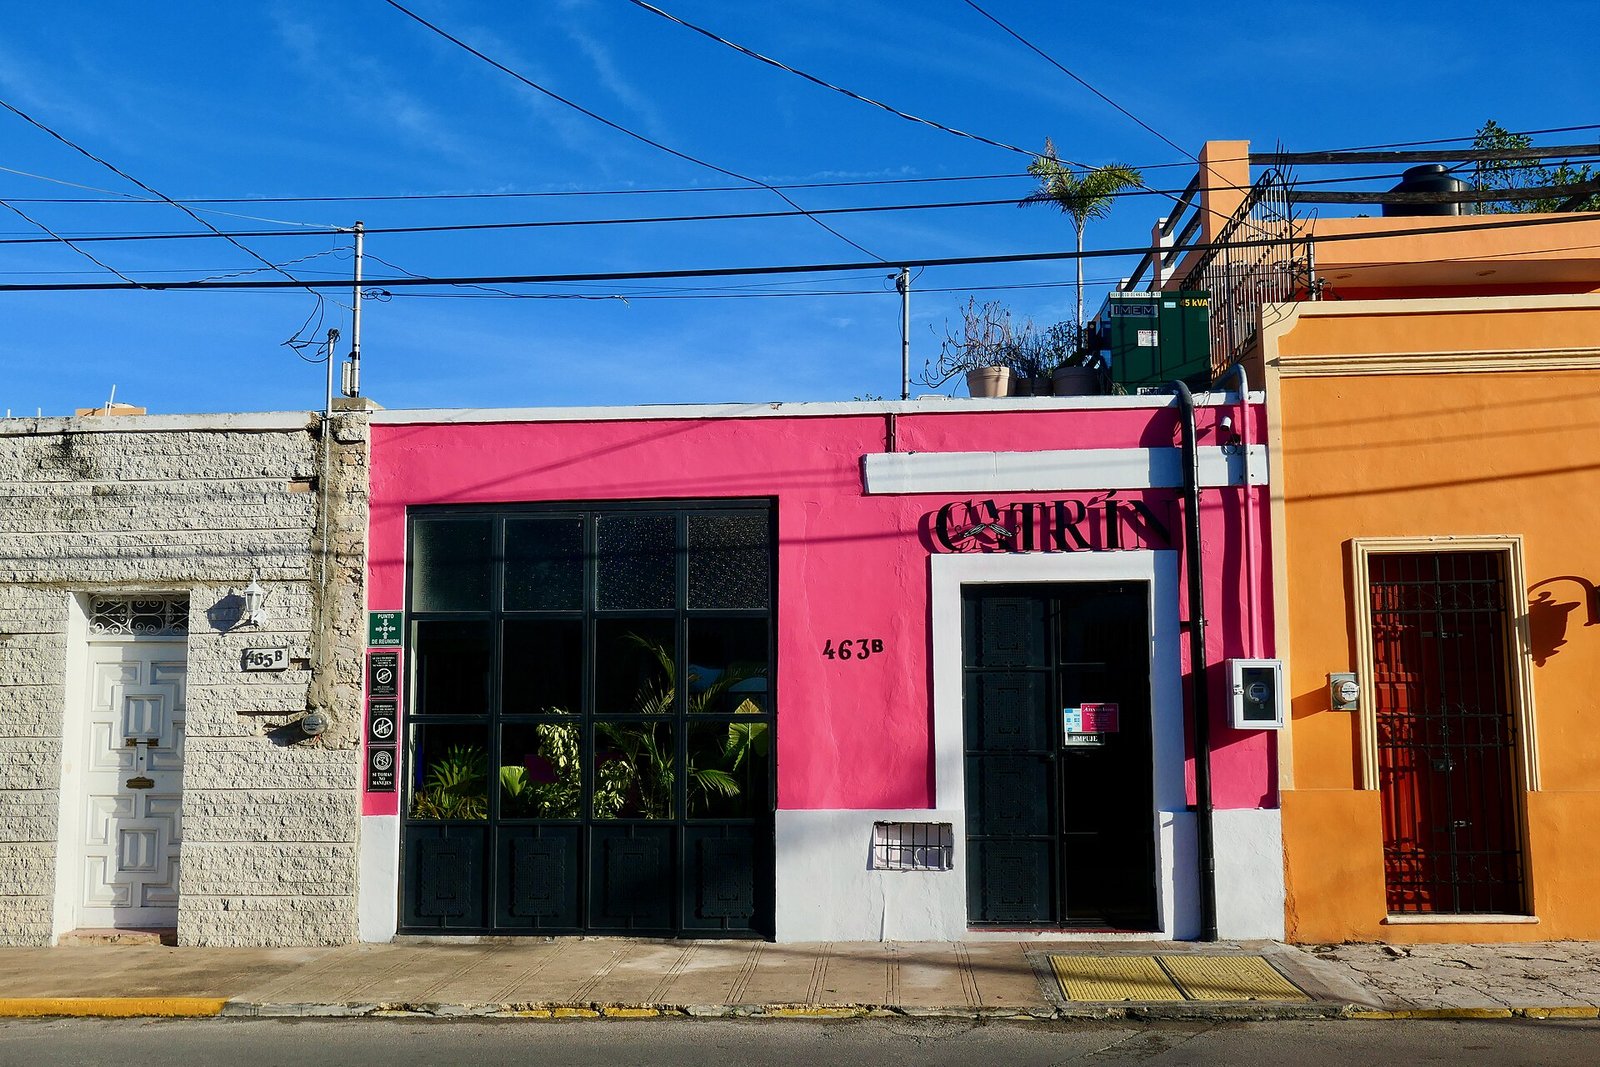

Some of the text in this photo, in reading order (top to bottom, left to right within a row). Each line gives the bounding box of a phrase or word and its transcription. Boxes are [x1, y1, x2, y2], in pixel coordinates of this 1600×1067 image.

[1114, 305, 1155, 315] IMEM
[1191, 299, 1209, 307] kVA
[935, 488, 1175, 551] CATRÍN
[822, 639, 884, 660] 463B
